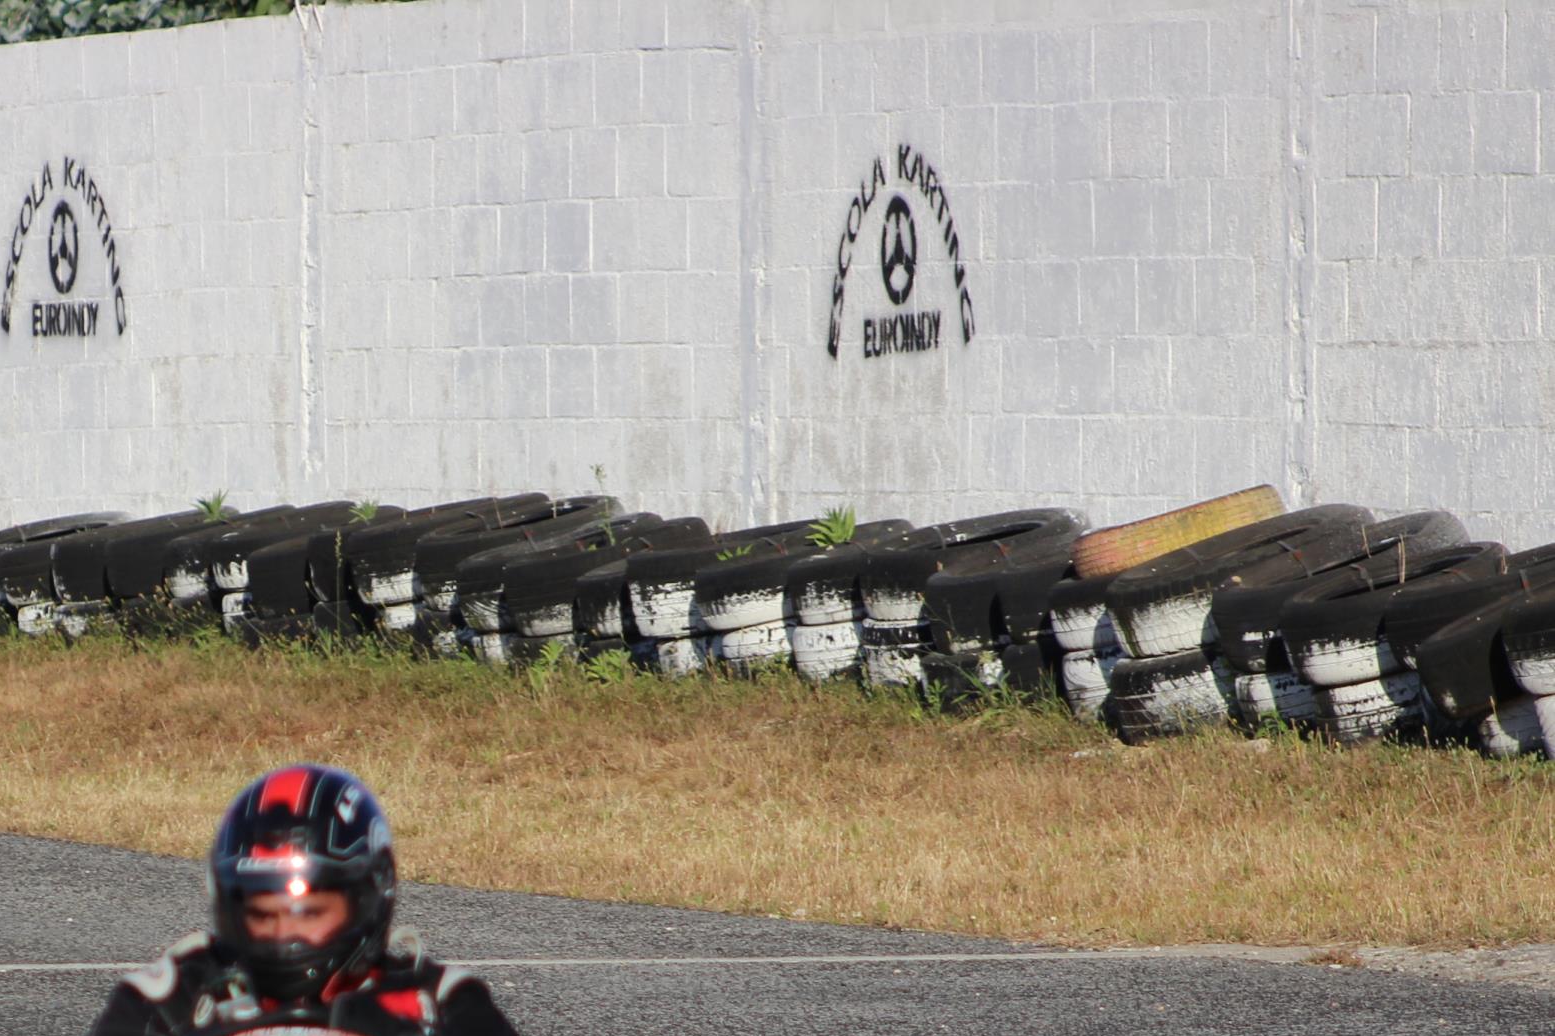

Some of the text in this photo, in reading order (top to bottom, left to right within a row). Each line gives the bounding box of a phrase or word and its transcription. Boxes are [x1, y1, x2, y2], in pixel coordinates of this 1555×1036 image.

[0, 156, 127, 337] ESCOLA KARTING
[827, 143, 976, 361] ESCOLA KARTING
[32, 302, 99, 337] EUROINDY
[863, 311, 941, 359] EUROINDY
